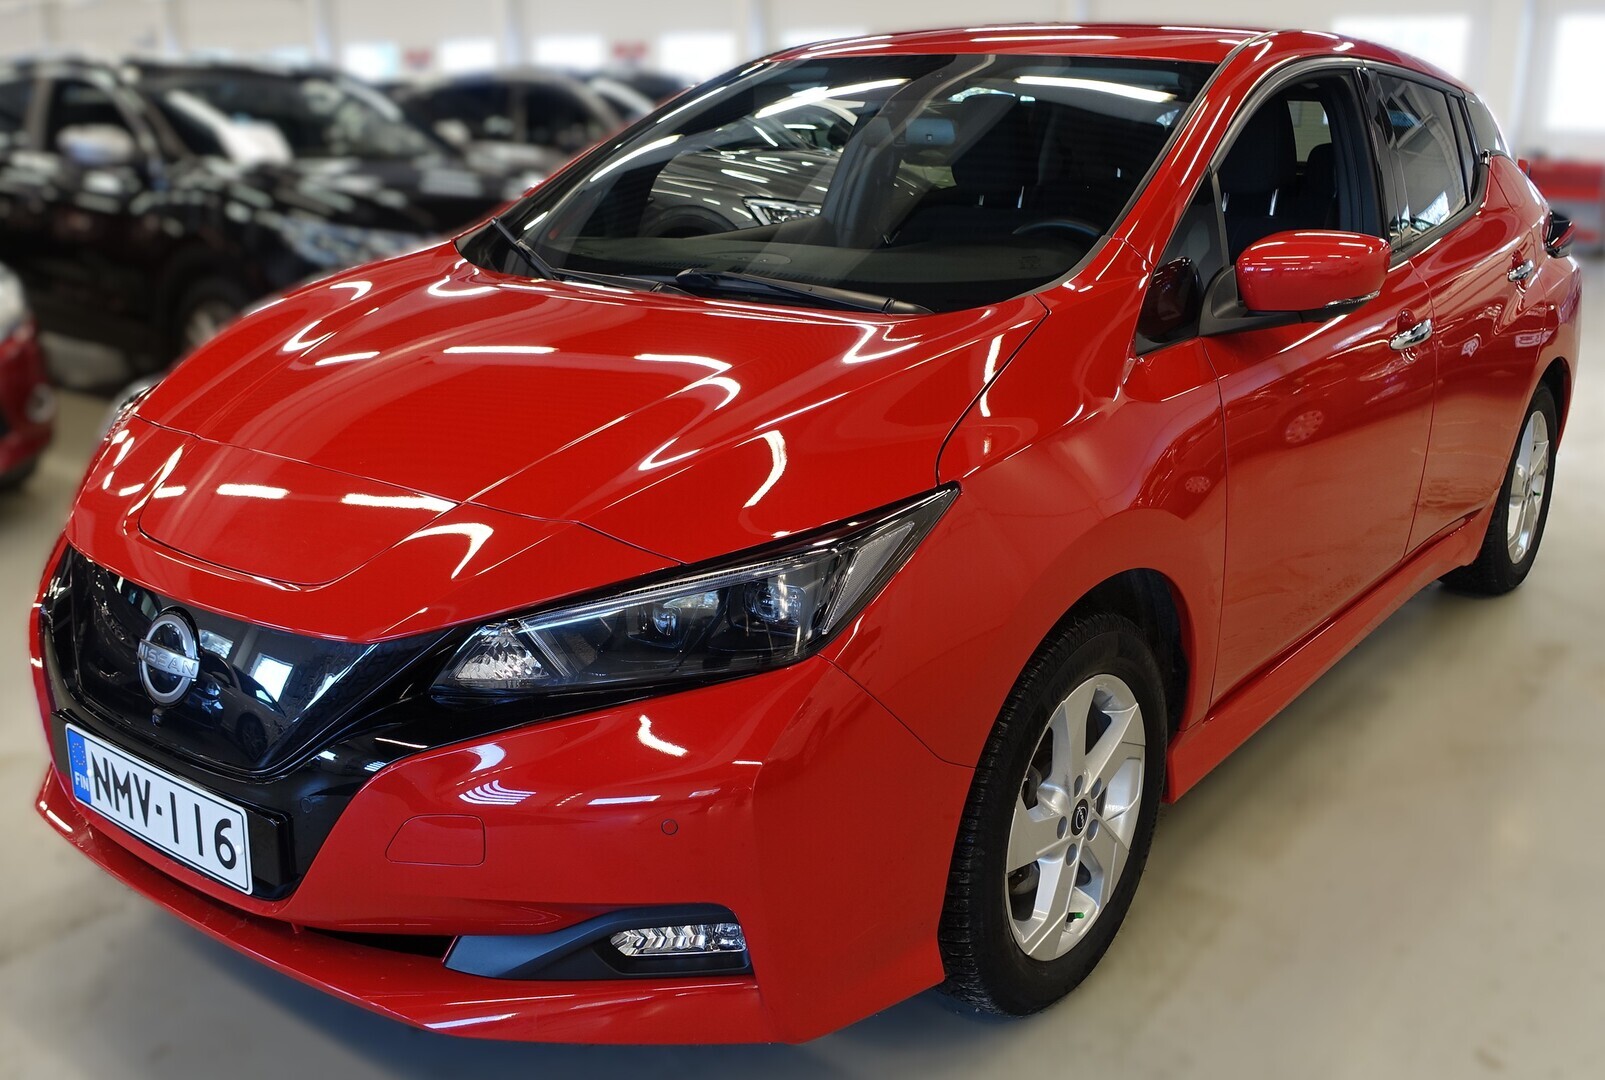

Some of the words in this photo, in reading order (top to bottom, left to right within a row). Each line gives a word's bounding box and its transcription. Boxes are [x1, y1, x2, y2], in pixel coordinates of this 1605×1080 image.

[138, 642, 196, 676] NISSAN
[74, 771, 90, 792] FIN
[91, 750, 237, 870] NMV-116
